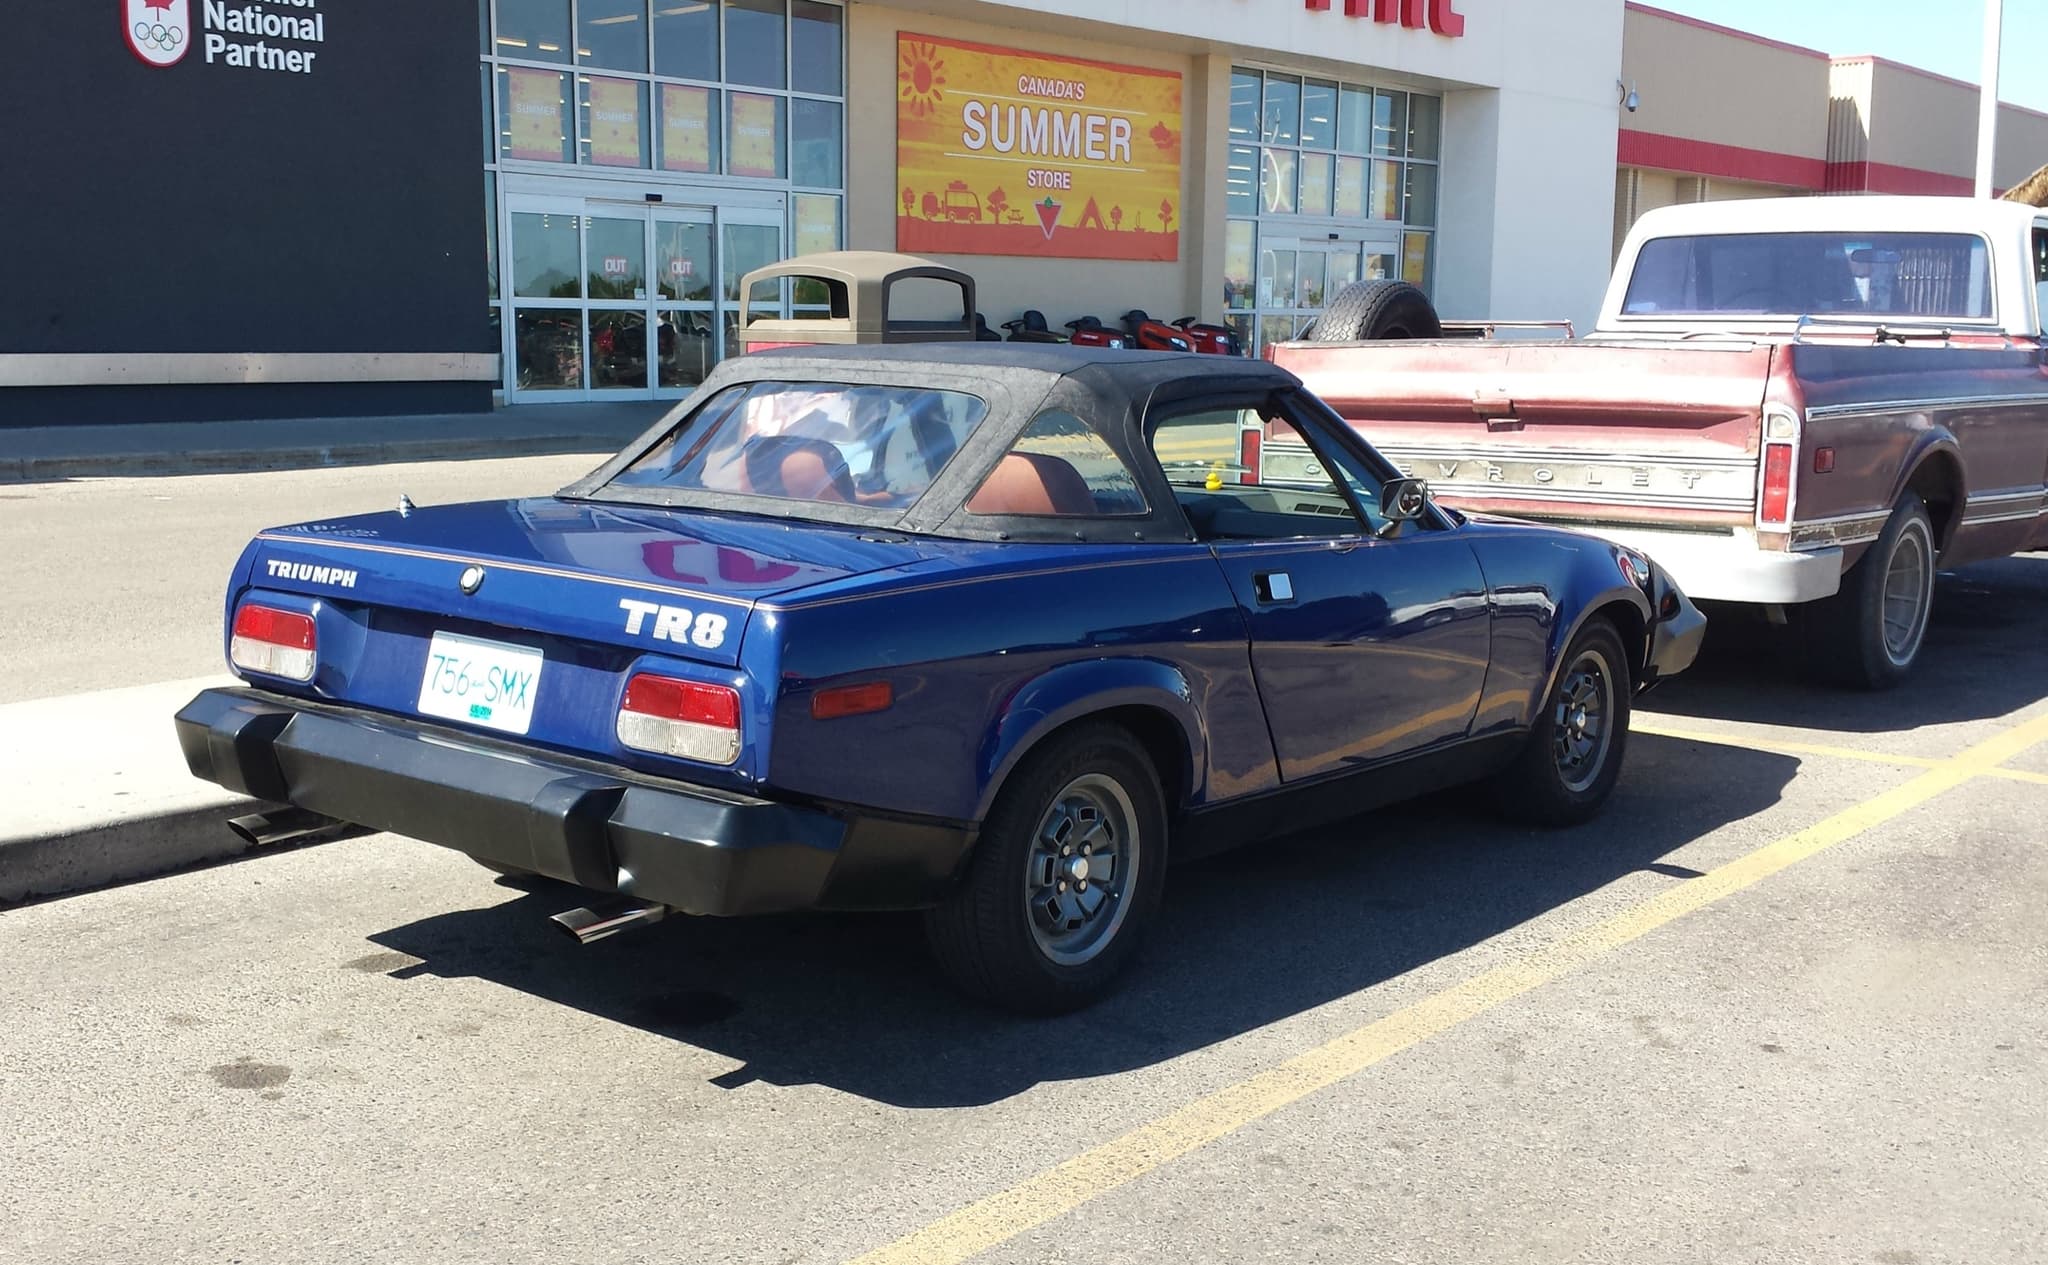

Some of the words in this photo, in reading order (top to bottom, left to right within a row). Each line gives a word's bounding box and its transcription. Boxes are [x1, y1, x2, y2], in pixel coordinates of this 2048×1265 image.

[203, 0, 324, 42] National
[204, 33, 315, 73] Partner
[1018, 74, 1086, 100] CANADA'S
[962, 100, 1132, 163] SUMMER
[1027, 168, 1072, 190] STORE
[604, 258, 627, 273] OUT
[671, 260, 692, 275] OUT
[1305, 461, 1700, 489] CEVROLET
[267, 559, 358, 589] TRIUMPH
[619, 598, 727, 649] TR8
[431, 653, 472, 697] 756
[484, 665, 533, 711] SMX
